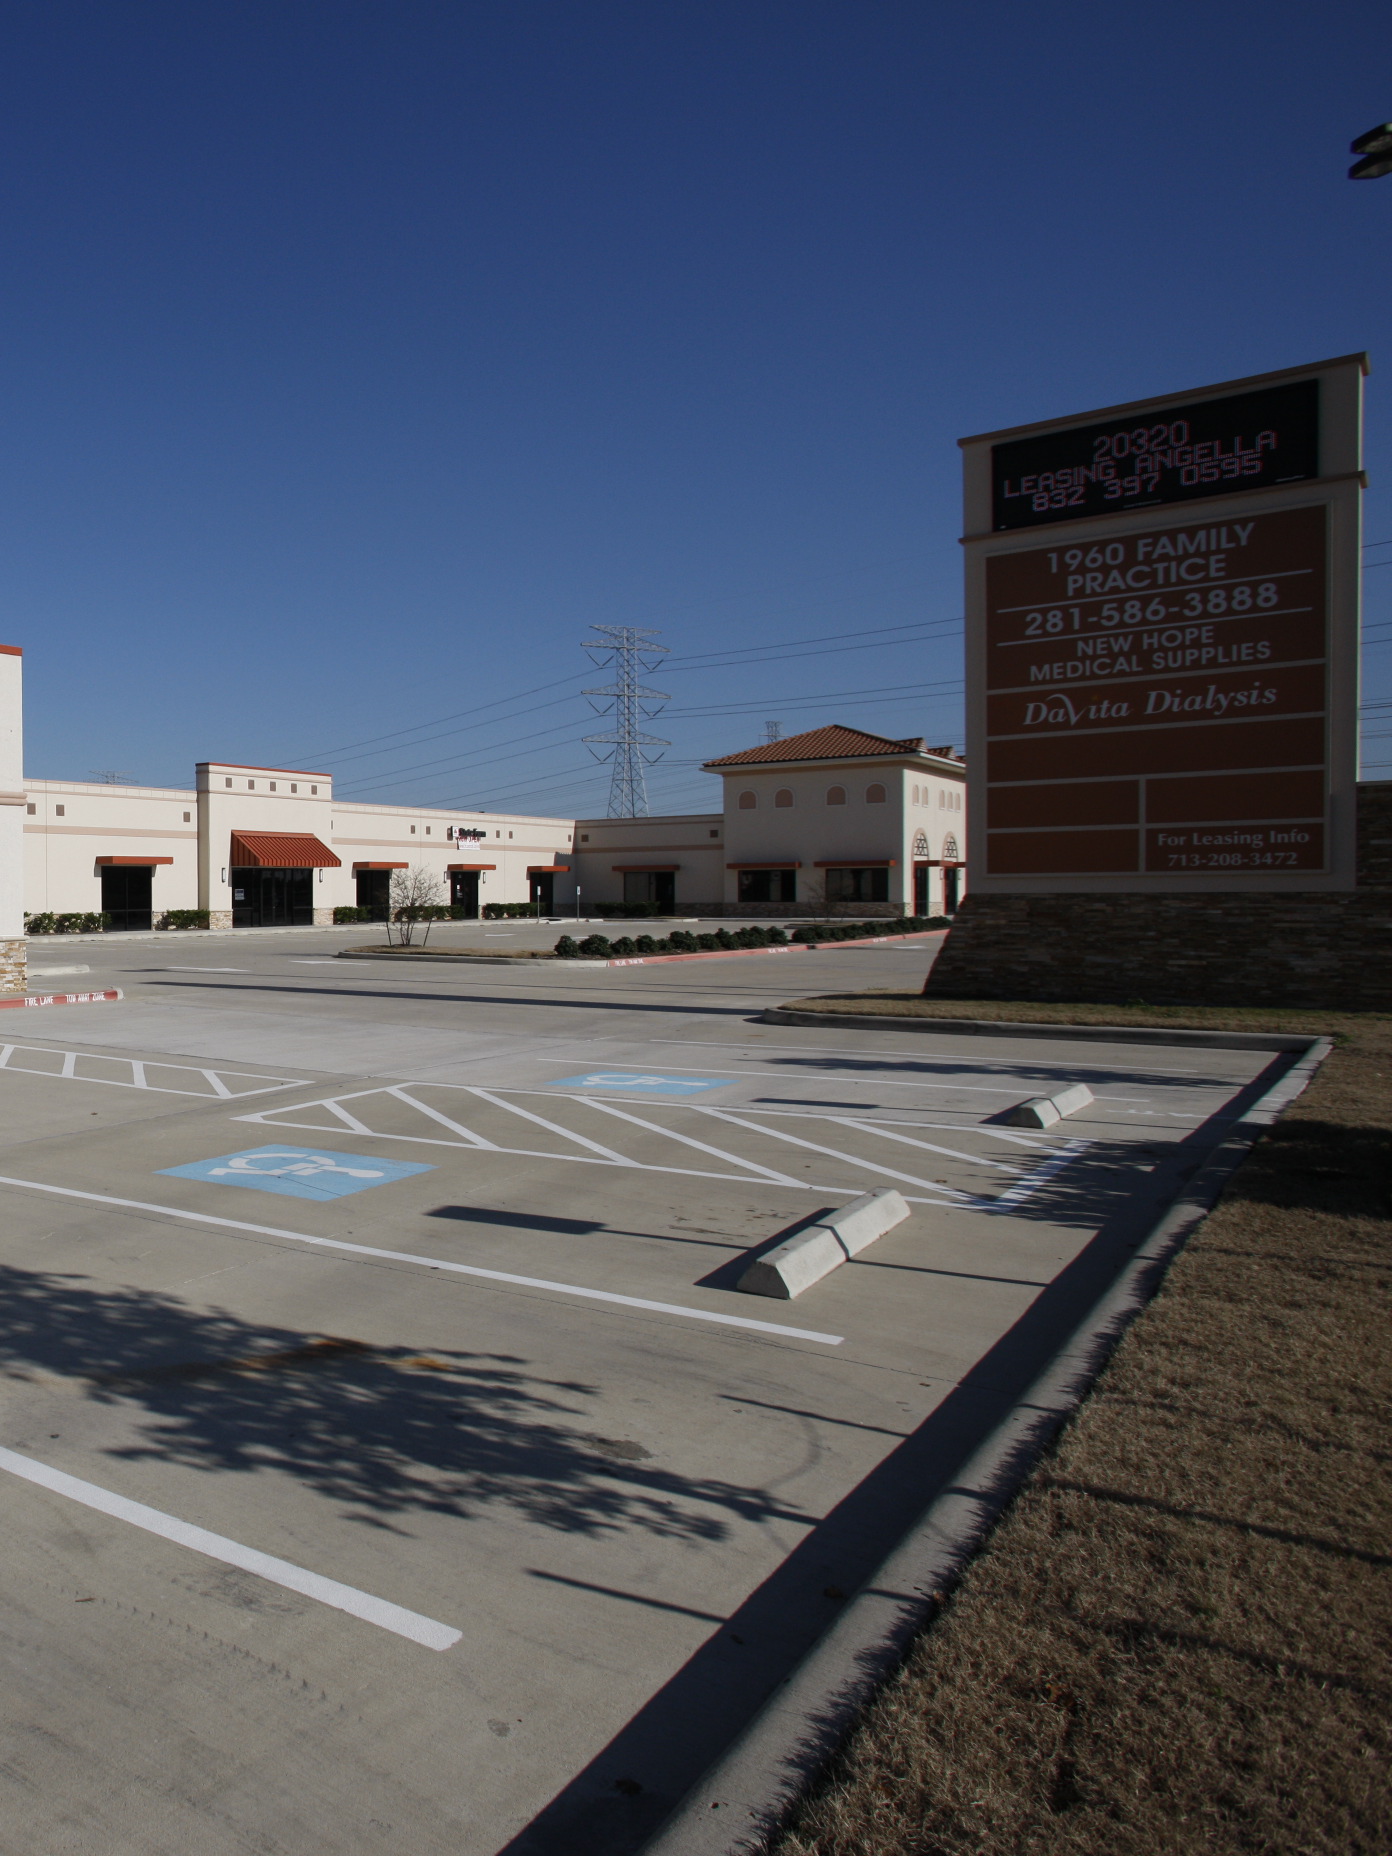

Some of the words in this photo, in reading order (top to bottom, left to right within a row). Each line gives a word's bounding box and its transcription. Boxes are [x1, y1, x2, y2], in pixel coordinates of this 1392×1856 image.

[1094, 419, 1190, 462] 20320
[1004, 459, 1117, 498] LEASING
[1135, 430, 1278, 475] ANGELLA
[1032, 485, 1085, 512] 832
[1104, 472, 1161, 499] 397
[1180, 453, 1263, 486] 0595
[1047, 543, 1125, 575] 1960
[1137, 522, 1256, 562] FAMILY
[1066, 554, 1227, 597] PRACTICE
[1025, 583, 1279, 636] 281-586-3888
[1030, 655, 1143, 682] MEDICAL
[1152, 641, 1272, 670] SUPPLIES
[1076, 635, 1134, 657] NEW
[1142, 625, 1215, 650] HOPE
[1022, 693, 1132, 727] DaVita
[1143, 681, 1278, 716] Dialysis
[1158, 833, 1187, 847] For
[1192, 831, 1264, 849] Leasing
[1269, 829, 1311, 844] Info
[1168, 852, 1299, 867] 713-208-3472
